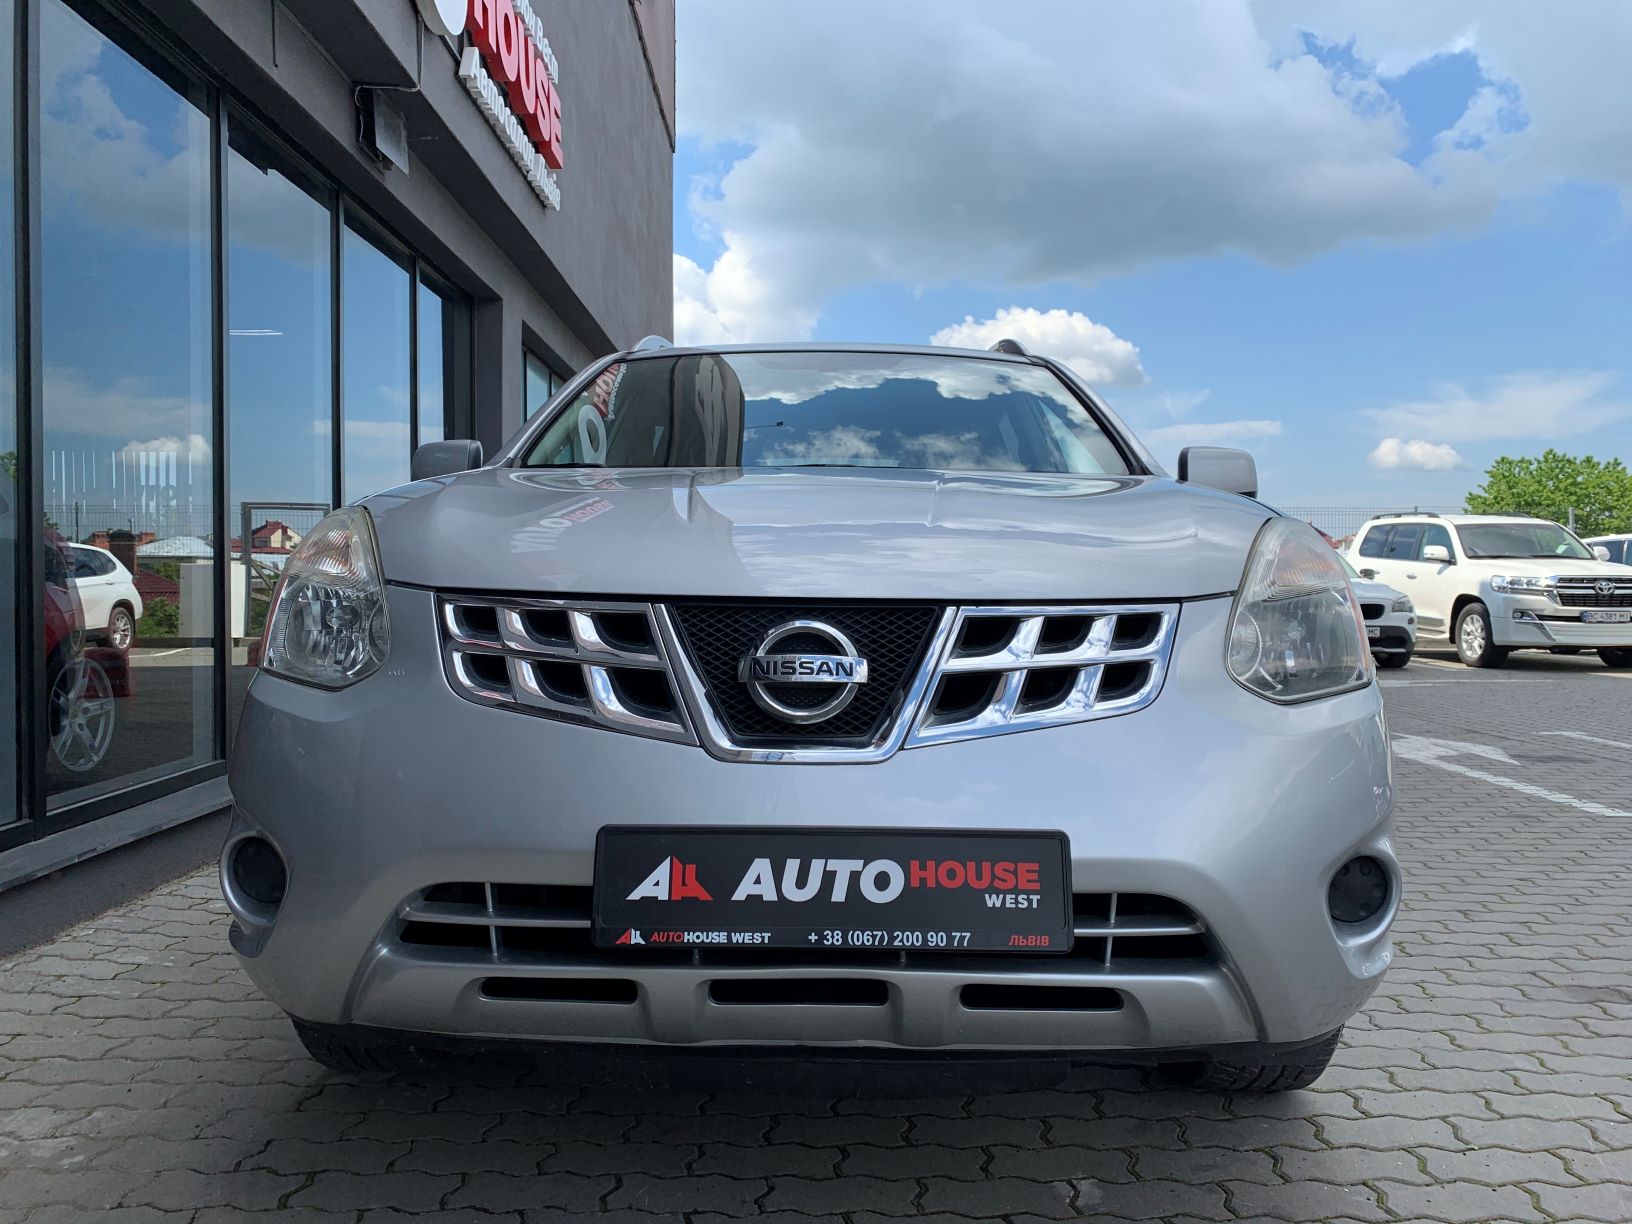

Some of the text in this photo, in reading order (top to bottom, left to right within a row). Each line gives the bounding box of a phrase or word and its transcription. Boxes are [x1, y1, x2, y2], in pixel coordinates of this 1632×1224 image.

[752, 660, 854, 677] NISSAN
[730, 857, 905, 904] AUTO
[910, 860, 1041, 890] HOUSE
[984, 893, 1041, 909] WEST
[650, 931, 728, 944] AUTOHOUSE
[731, 931, 771, 944] WEST
[823, 930, 843, 946] 38
[847, 931, 888, 947] (067)
[893, 931, 923, 947] 200
[927, 931, 947, 947] 90
[951, 932, 971, 947] 77
[1008, 935, 1050, 947] ЛЬВІВ
